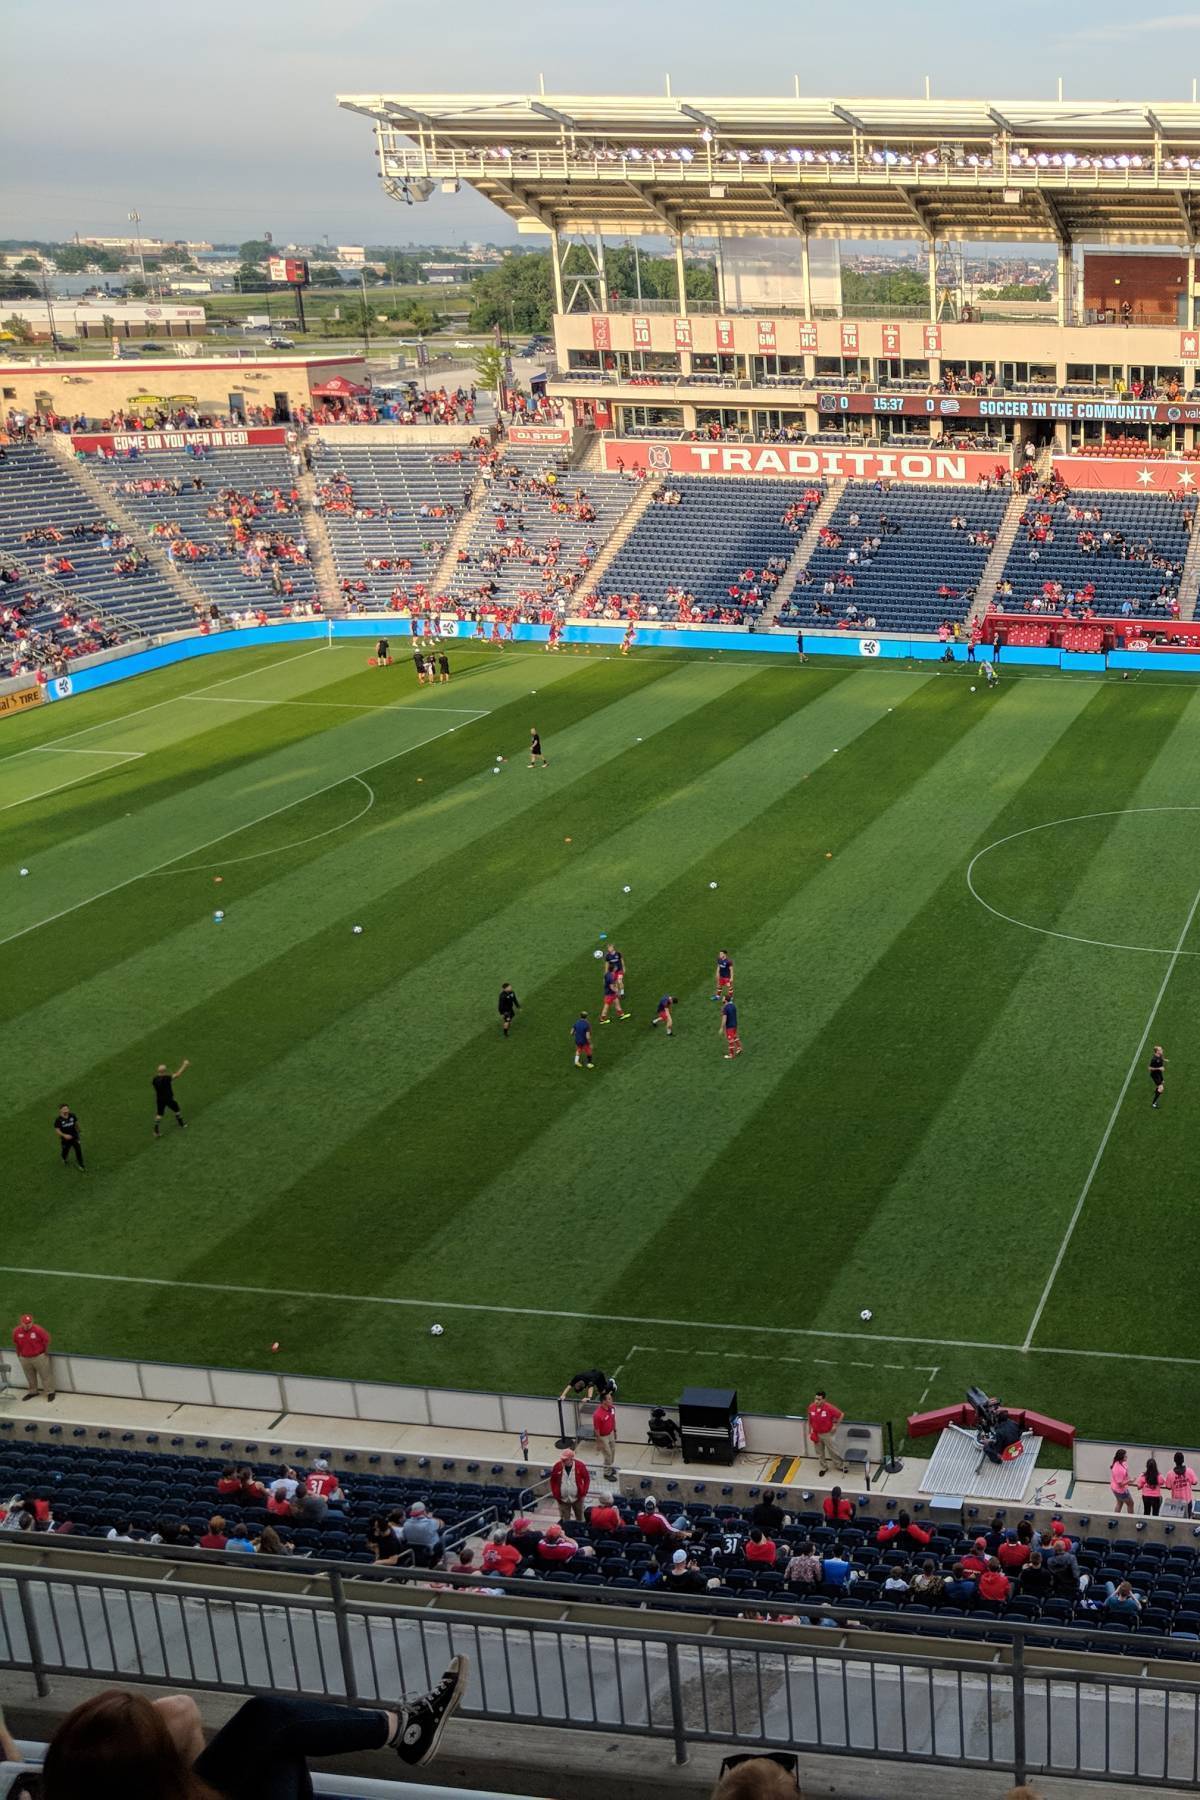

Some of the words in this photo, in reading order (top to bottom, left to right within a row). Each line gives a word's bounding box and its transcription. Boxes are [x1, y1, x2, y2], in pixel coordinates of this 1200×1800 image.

[635, 329, 649, 342] 10
[676, 330, 691, 342] 41
[721, 331, 730, 344] 5
[760, 333, 776, 345] GM
[801, 334, 817, 347] HC
[843, 334, 857, 347] 14
[887, 335, 895, 349] 2
[928, 337, 936, 350] 9
[840, 396, 849, 409] 0
[873, 397, 904, 411] 15:37
[926, 399, 935, 412] 0
[979, 401, 1028, 416] SOCCER
[1031, 402, 1047, 417] IN
[1050, 403, 1073, 418] THE
[1077, 404, 1157, 420] COMMUNITY
[113, 435, 146, 450] COME
[147, 435, 162, 449] ON
[163, 434, 185, 448] YOU
[186, 432, 210, 447] MEN
[212, 431, 223, 446] IN
[225, 431, 248, 445] RED!
[691, 448, 965, 480] TRADITION
[19, 691, 40, 705] TIRE
[310, 1480, 324, 1497] 31
[723, 1538, 738, 1554] 31
